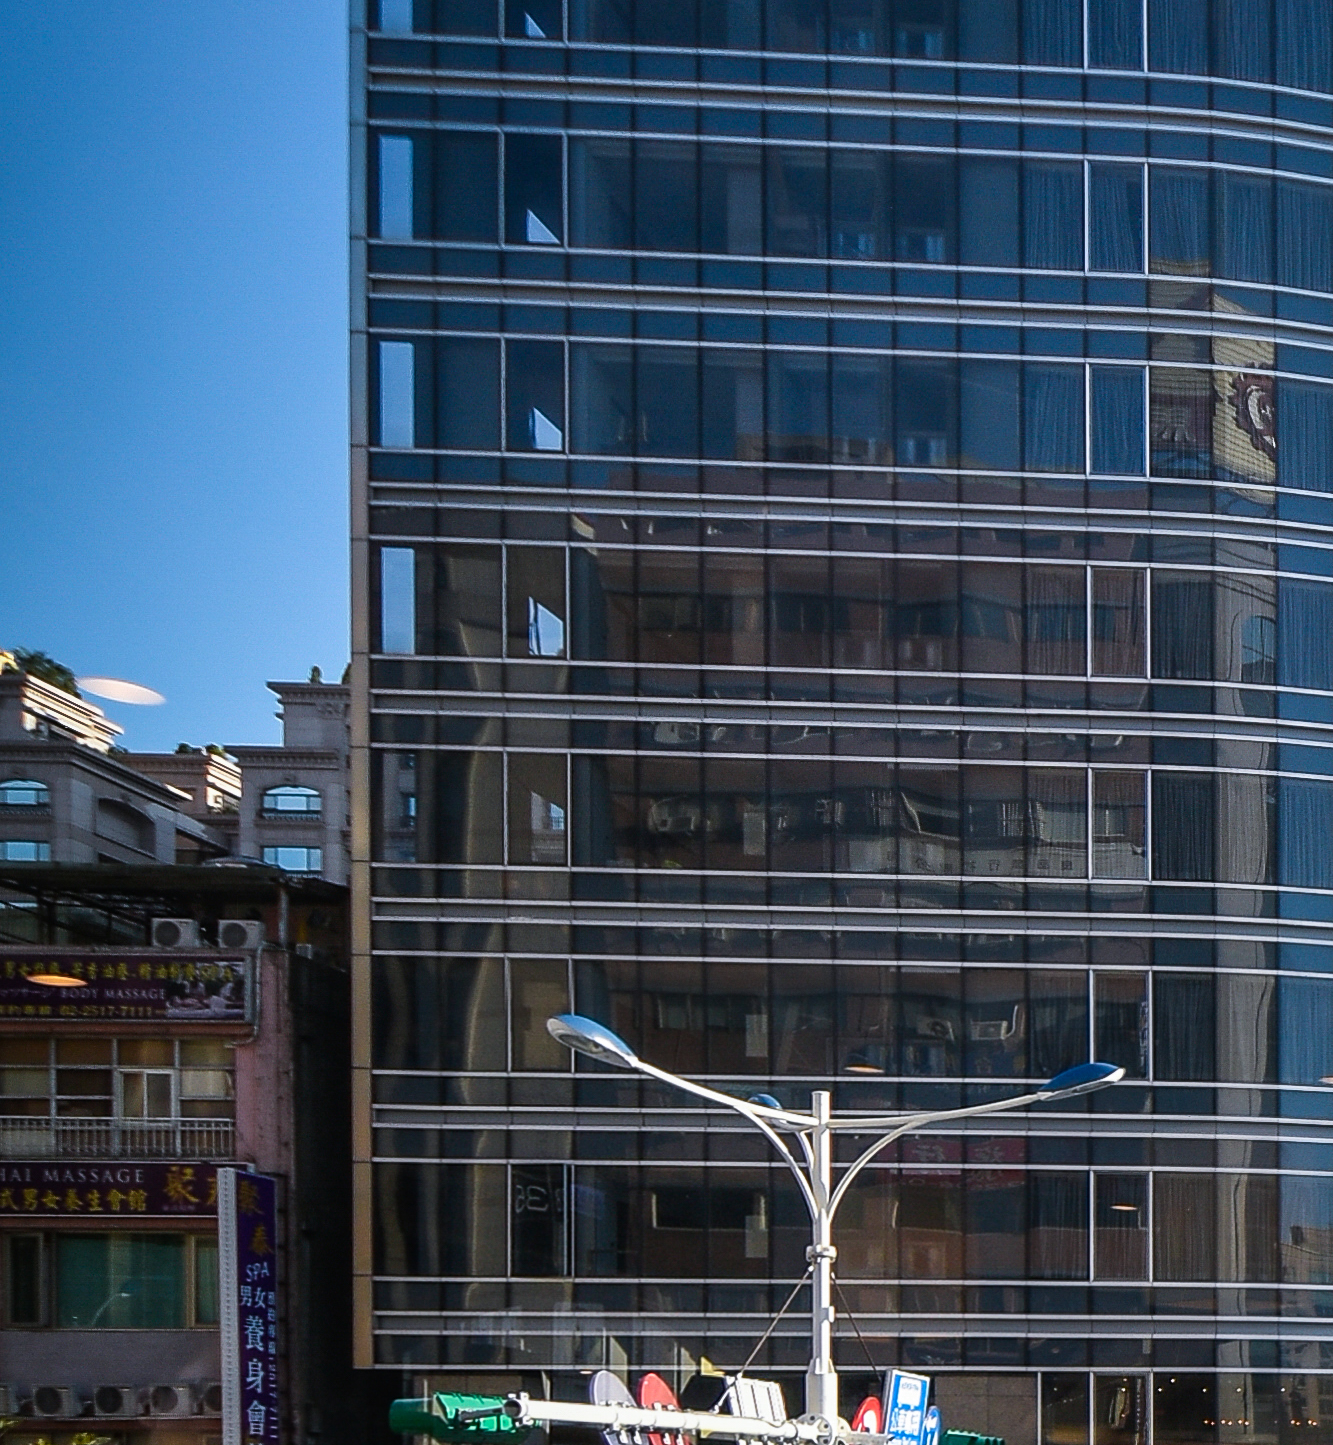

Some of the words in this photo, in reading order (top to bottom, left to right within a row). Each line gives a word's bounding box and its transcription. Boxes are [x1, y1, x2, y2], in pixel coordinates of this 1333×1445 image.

[104, 987, 166, 1000] MASSAGE
[42, 1167, 145, 1184] MASSAGE
[245, 1262, 270, 1282] SPA
